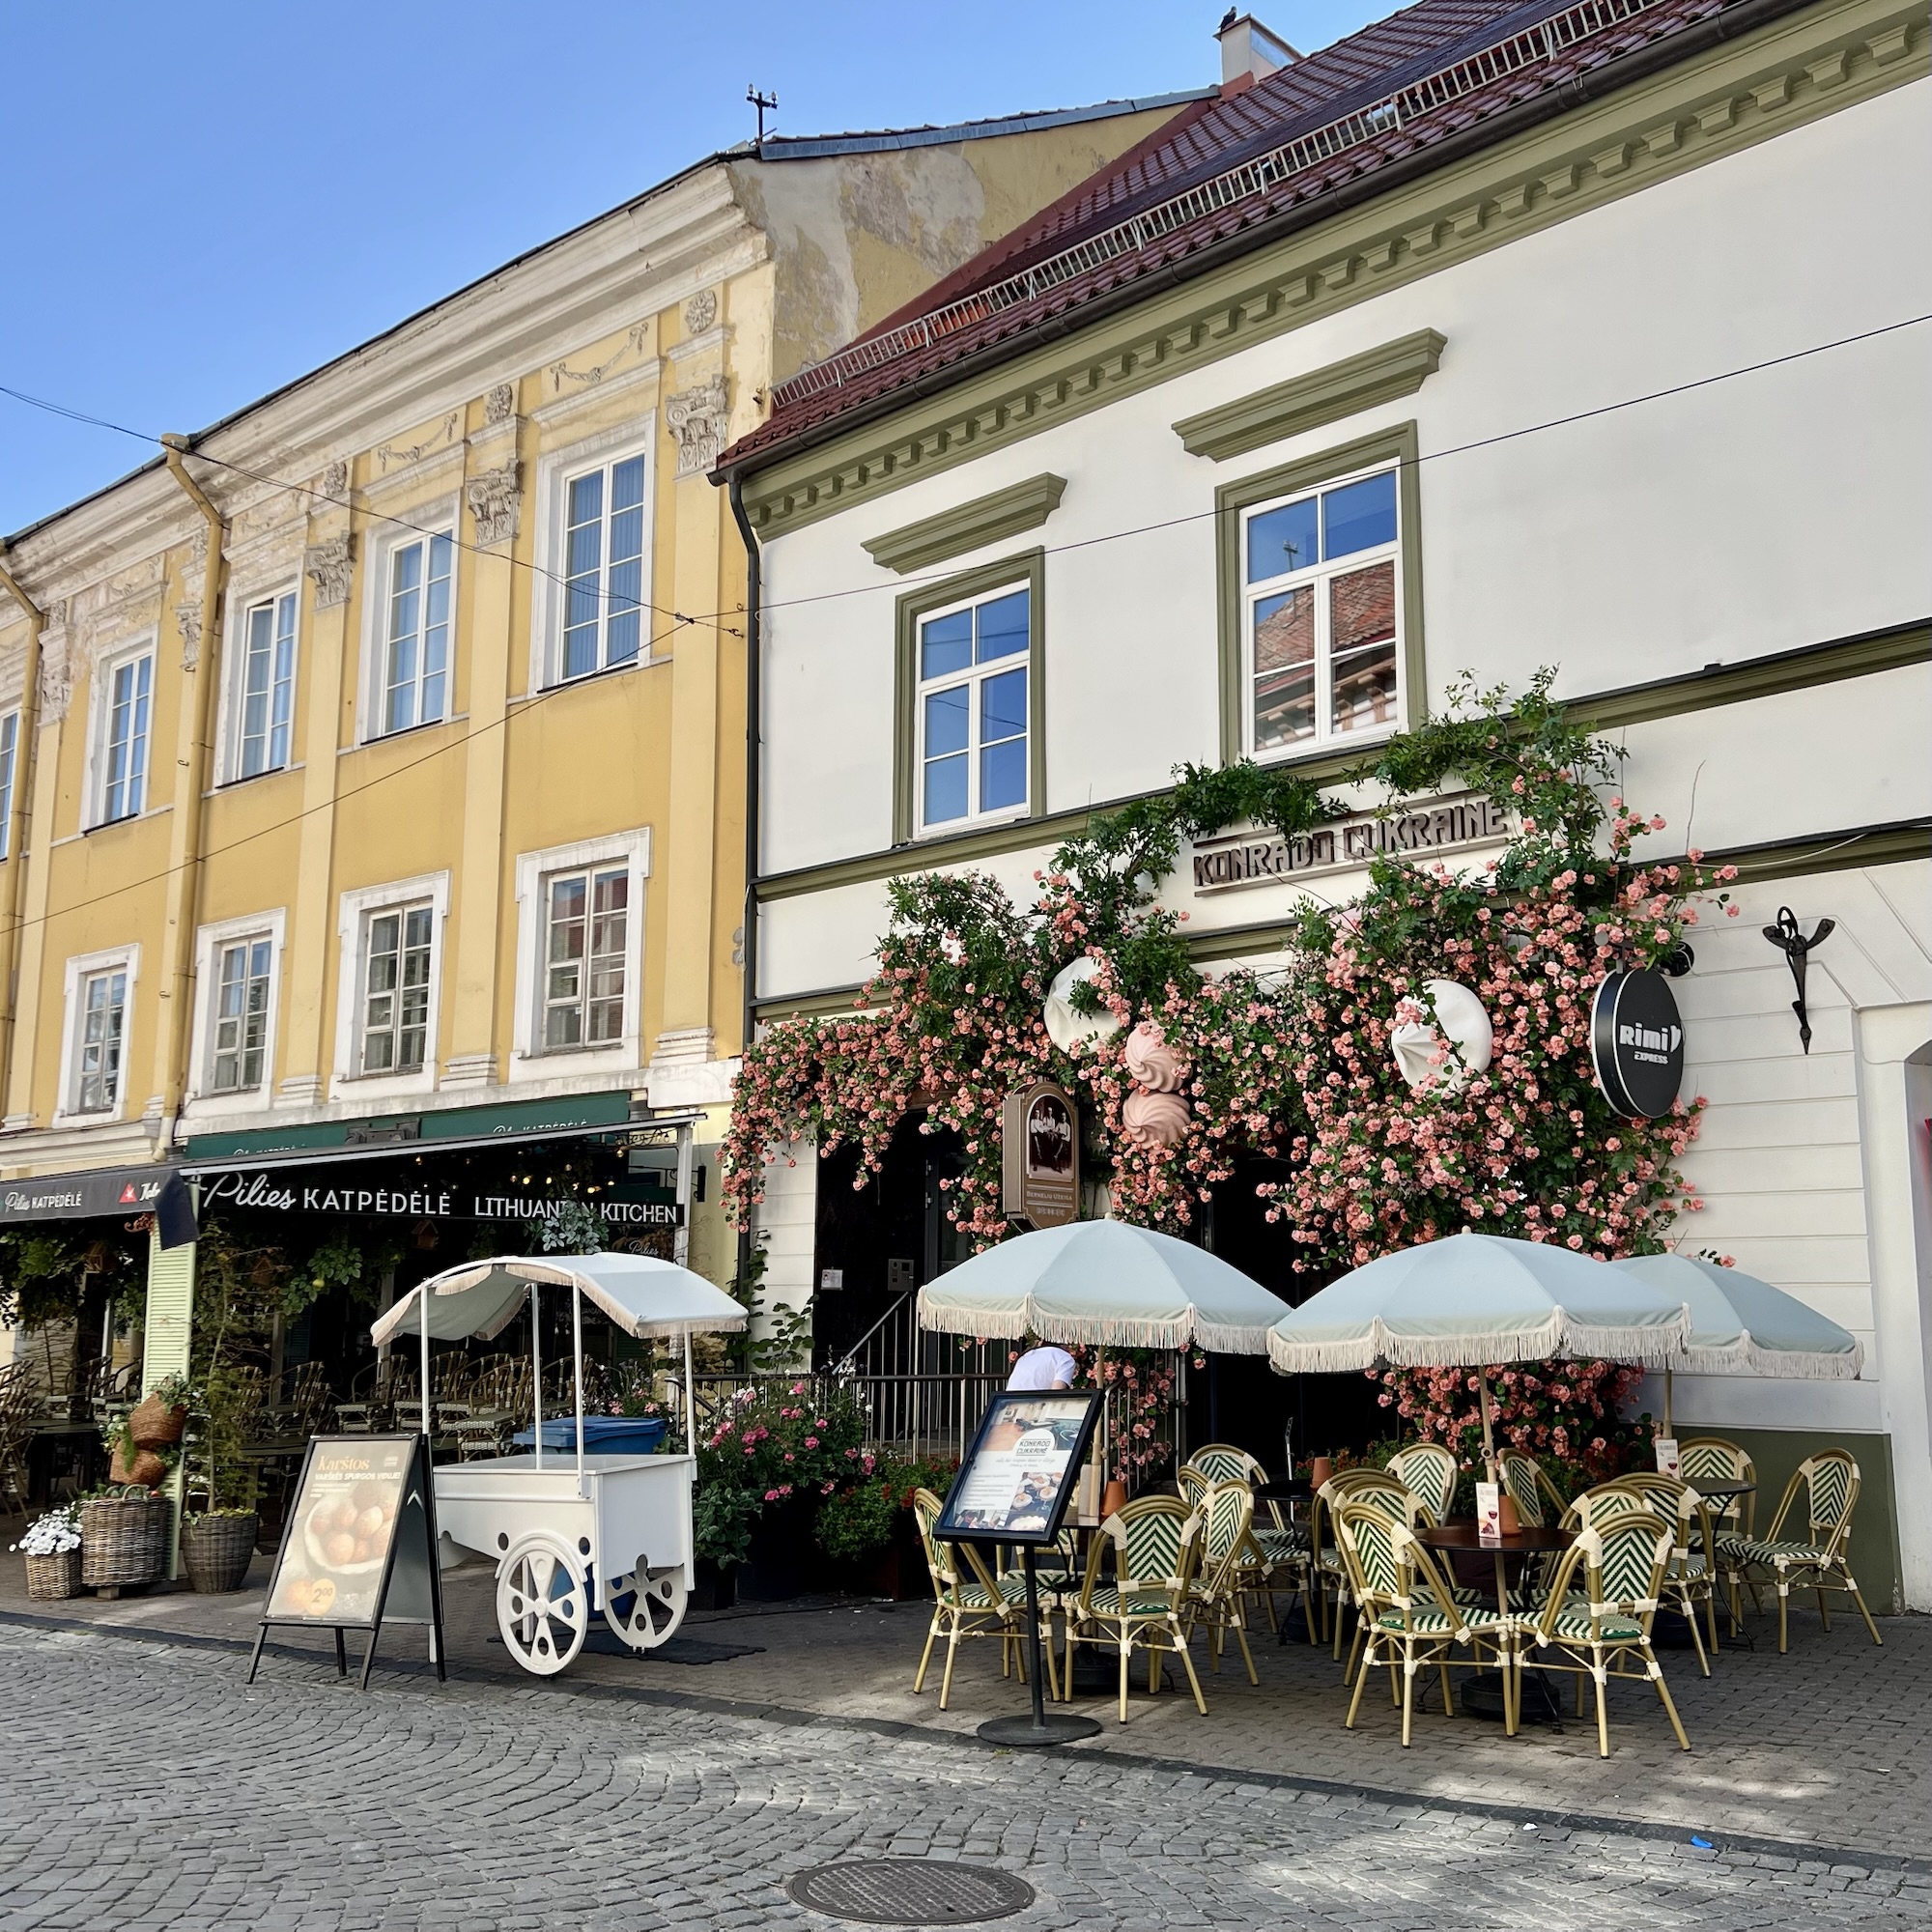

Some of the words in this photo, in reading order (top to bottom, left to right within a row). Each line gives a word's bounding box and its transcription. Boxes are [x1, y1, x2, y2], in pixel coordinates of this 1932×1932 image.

[1193, 830, 1335, 887] KONRADO
[1619, 1022, 1668, 1052] Rimi
[1634, 1051, 1668, 1065] EXPRESS
[199, 1171, 297, 1210] Pilies
[303, 1188, 450, 1215] KATPĖDĖLĖ
[601, 1203, 676, 1224] KITCHEN
[317, 1455, 371, 1471] Karštos
